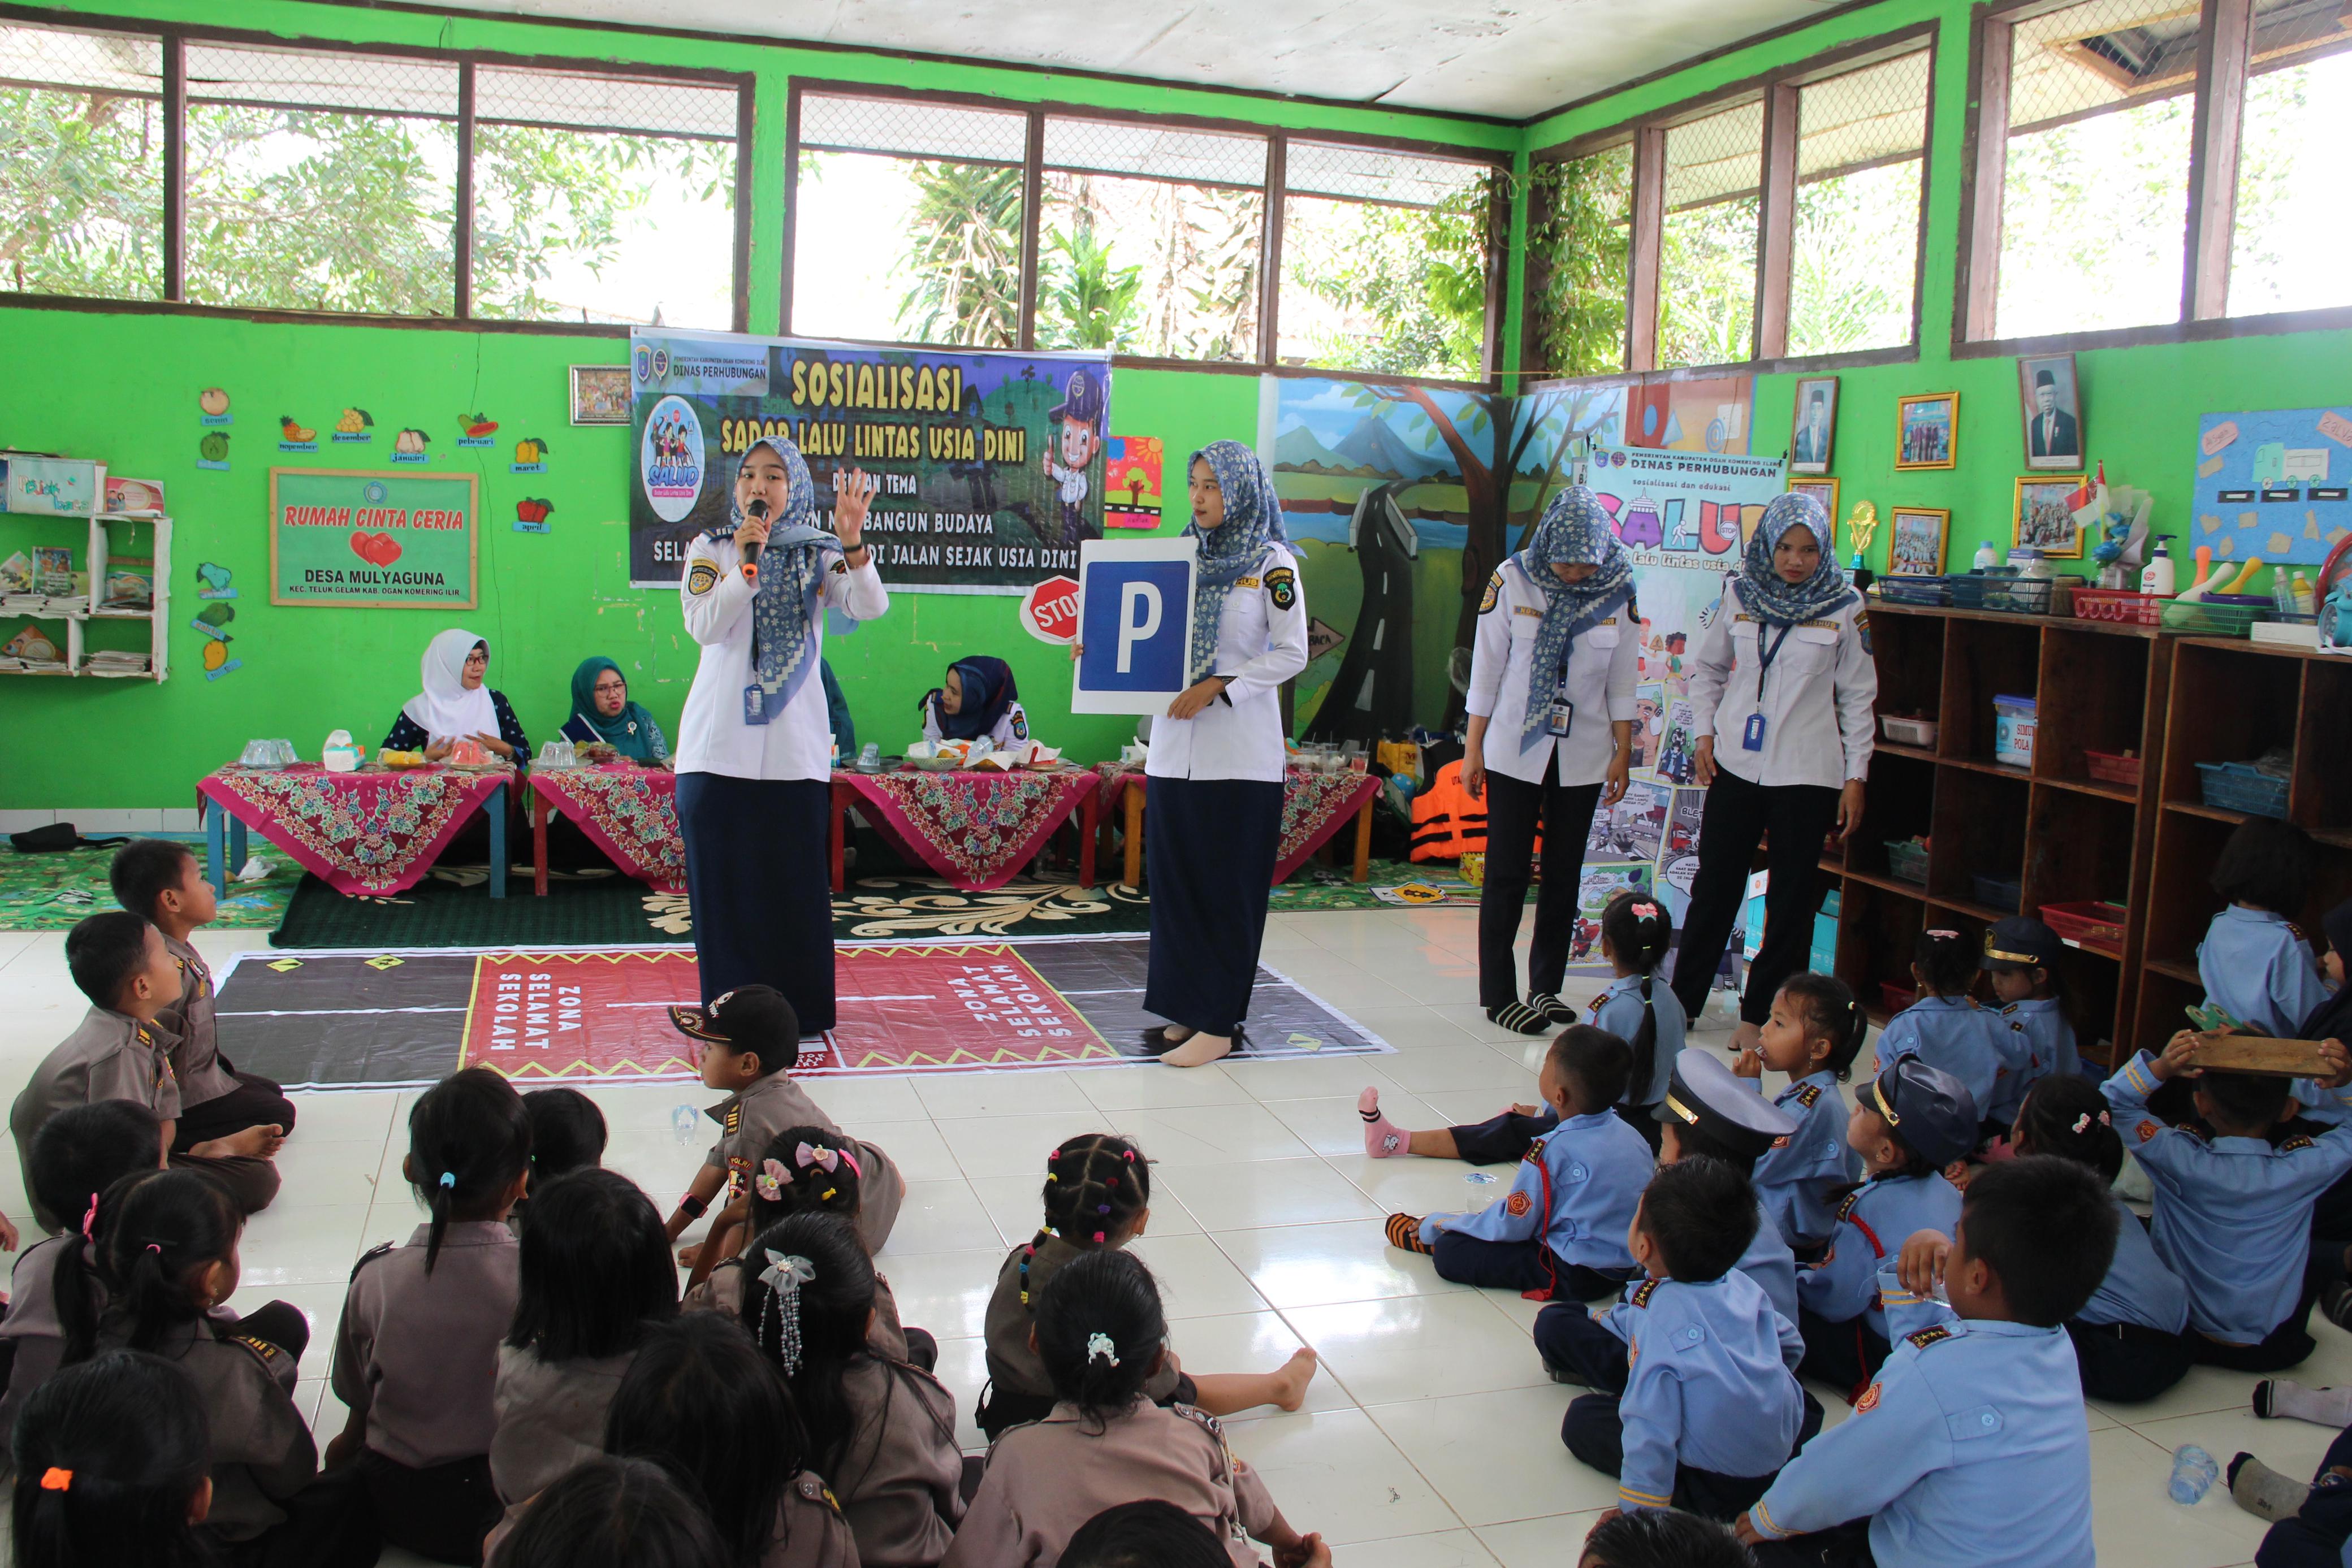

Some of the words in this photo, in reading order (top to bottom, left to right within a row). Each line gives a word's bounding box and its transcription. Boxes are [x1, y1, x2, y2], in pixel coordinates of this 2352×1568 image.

[674, 366, 701, 376] DINAS
[703, 366, 766, 379] PERHUBUNGAN
[793, 360, 961, 413] SOSIALISASI
[459, 438, 494, 447] pebruari
[799, 422, 846, 456] LALU
[855, 424, 920, 458] LINTAS
[929, 427, 975, 461] USIA
[984, 430, 1024, 462] DINI
[393, 453, 425, 462] januari
[648, 465, 699, 487] SALUD
[1631, 459, 1673, 470] DINAS
[1678, 462, 1776, 478] PERHUBUNGAN
[886, 474, 917, 495] TEMA
[1632, 479, 1677, 487] sosialisasi
[1698, 483, 1731, 491] edukasi
[284, 506, 351, 527] RUMAH
[356, 508, 407, 529] CINTA
[413, 509, 463, 530] CERIA
[828, 510, 928, 532] MBANGUN
[935, 513, 993, 534] BUDAYA
[890, 544, 940, 565] JALAN
[945, 546, 993, 567] SEJAK
[998, 548, 1035, 568] USIA
[1041, 549, 1077, 569] DINI
[1632, 552, 1658, 565] lalu
[1661, 553, 1700, 569] lintas
[1703, 558, 1729, 571] usia
[305, 569, 344, 583] DESA
[349, 571, 445, 586] MULYAGUNA
[1117, 581, 1163, 674] P
[2017, 724, 2035, 737] SIMU
[2014, 738, 2030, 751] POLA
[558, 986, 582, 1032] ZONA
[947, 978, 1000, 1022] ZONA
[962, 965, 1041, 1037] SELAMAT
[989, 965, 1072, 1037] SEKOLAH
[490, 973, 522, 1050] SEKOLAH
[525, 973, 552, 1049] SELAMAT
[730, 1158, 751, 1168] POLRI
[1635, 1297, 1645, 1306] TNI
[1912, 1336, 1925, 1346] TNI
